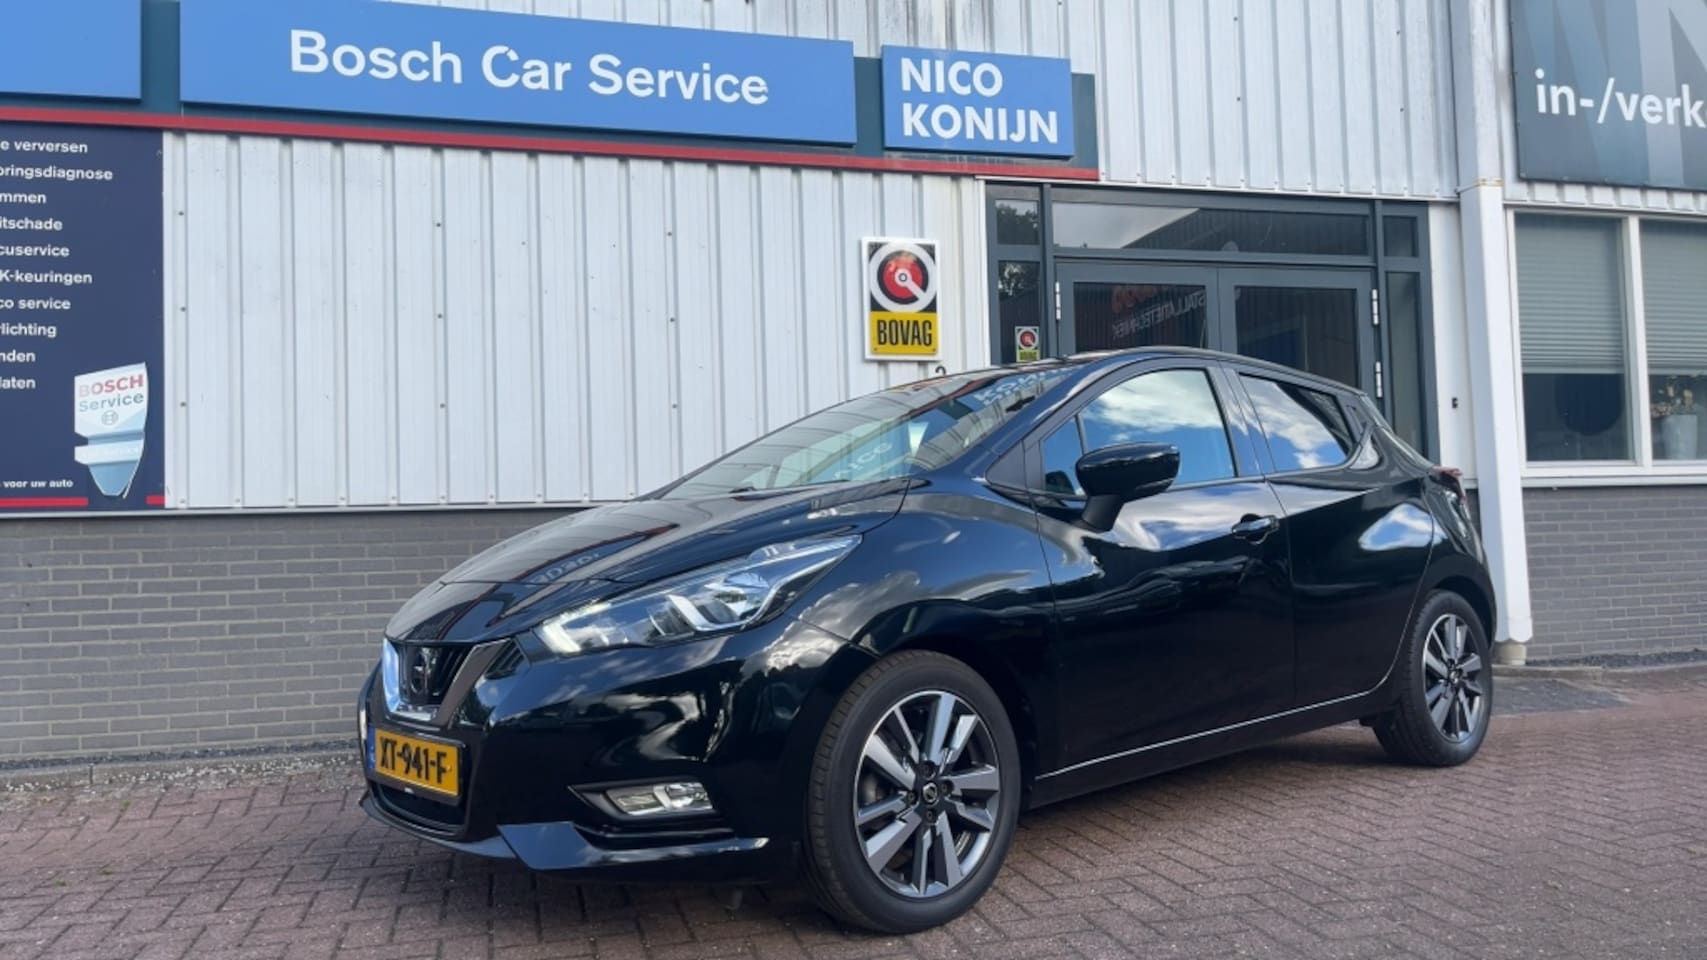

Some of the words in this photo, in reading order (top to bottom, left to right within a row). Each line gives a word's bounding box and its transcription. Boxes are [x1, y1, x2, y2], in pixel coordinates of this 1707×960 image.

[290, 28, 463, 84] Bosch
[481, 45, 571, 91] Car
[589, 53, 769, 105] Service
[900, 58, 1003, 97] NICO
[1535, 68, 1707, 128] in-/verk
[902, 103, 1058, 144] KONIJN
[14, 141, 88, 154] verversen
[18, 297, 71, 310] service
[876, 319, 933, 347] BOVAG
[78, 374, 145, 398] BOSCH
[78, 393, 145, 413] Service
[3, 480, 27, 489] voor
[31, 480, 45, 489] uw
[49, 479, 73, 489] auto
[379, 736, 447, 784] XT-941-F
